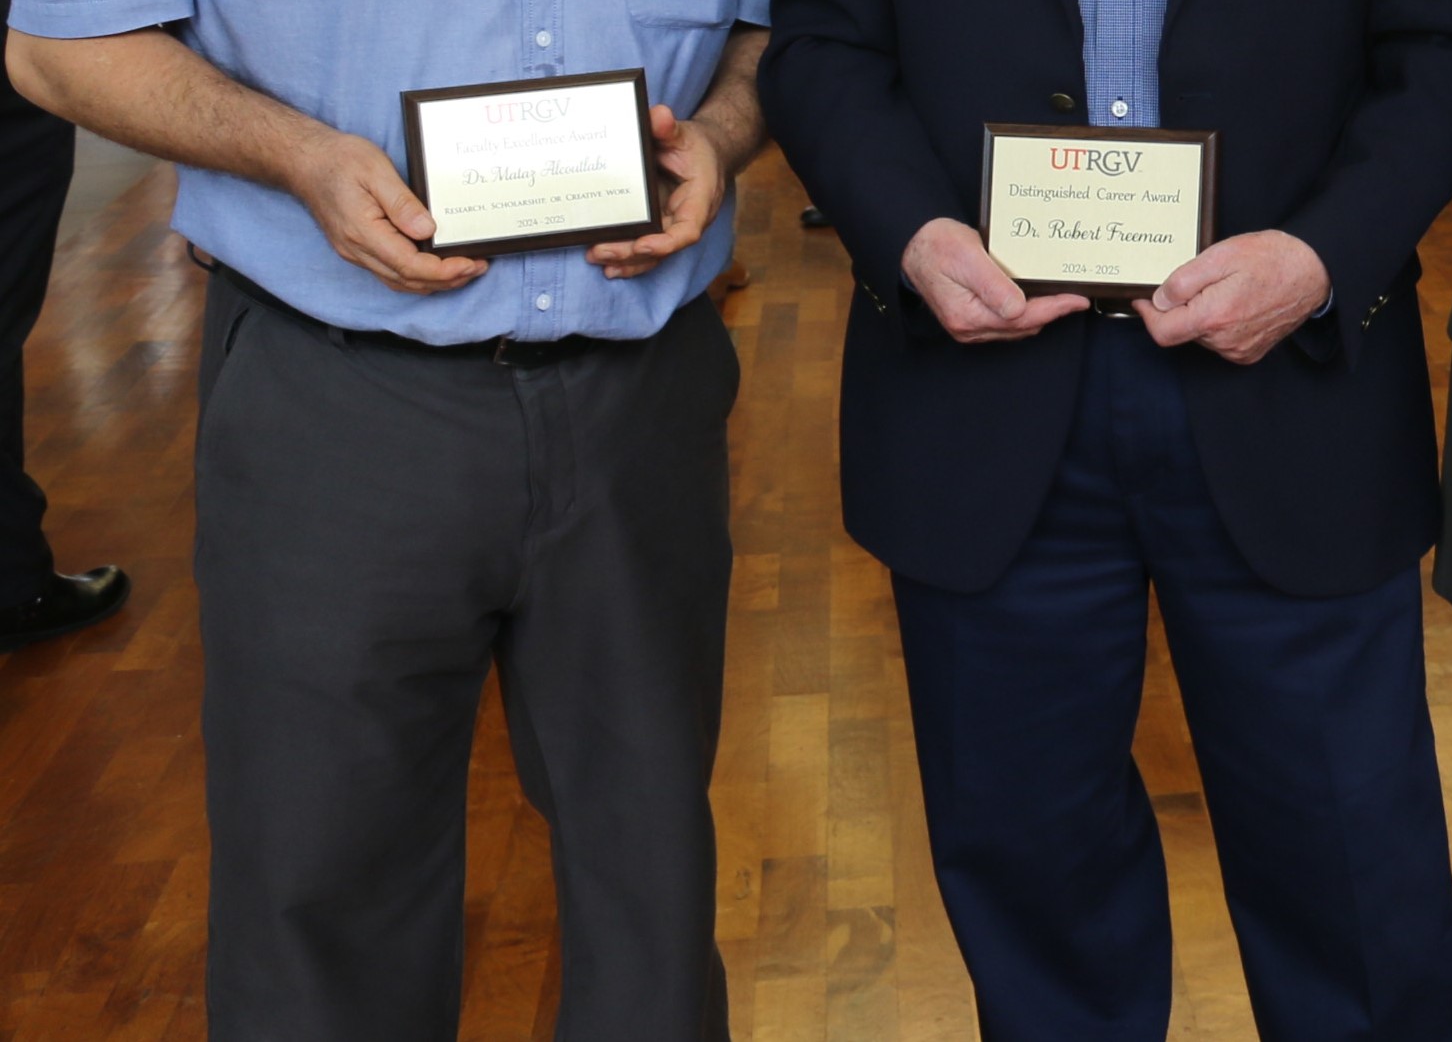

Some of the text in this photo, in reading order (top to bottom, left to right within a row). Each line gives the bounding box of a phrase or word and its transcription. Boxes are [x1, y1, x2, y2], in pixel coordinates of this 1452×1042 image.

[485, 97, 571, 124] UTRGV
[456, 125, 607, 157] Faculty Excellence Award
[462, 155, 607, 187] Dr. Mataz Alcoutlabi
[1050, 148, 1143, 177] UTRGV
[1008, 183, 1181, 204] Distinguished Career Award
[517, 217, 538, 228] 2024
[545, 214, 566, 225] 2025
[1010, 217, 1175, 243] Dr. Robert Freeman
[1062, 263, 1087, 274] 2024
[1096, 265, 1120, 275] 2025
